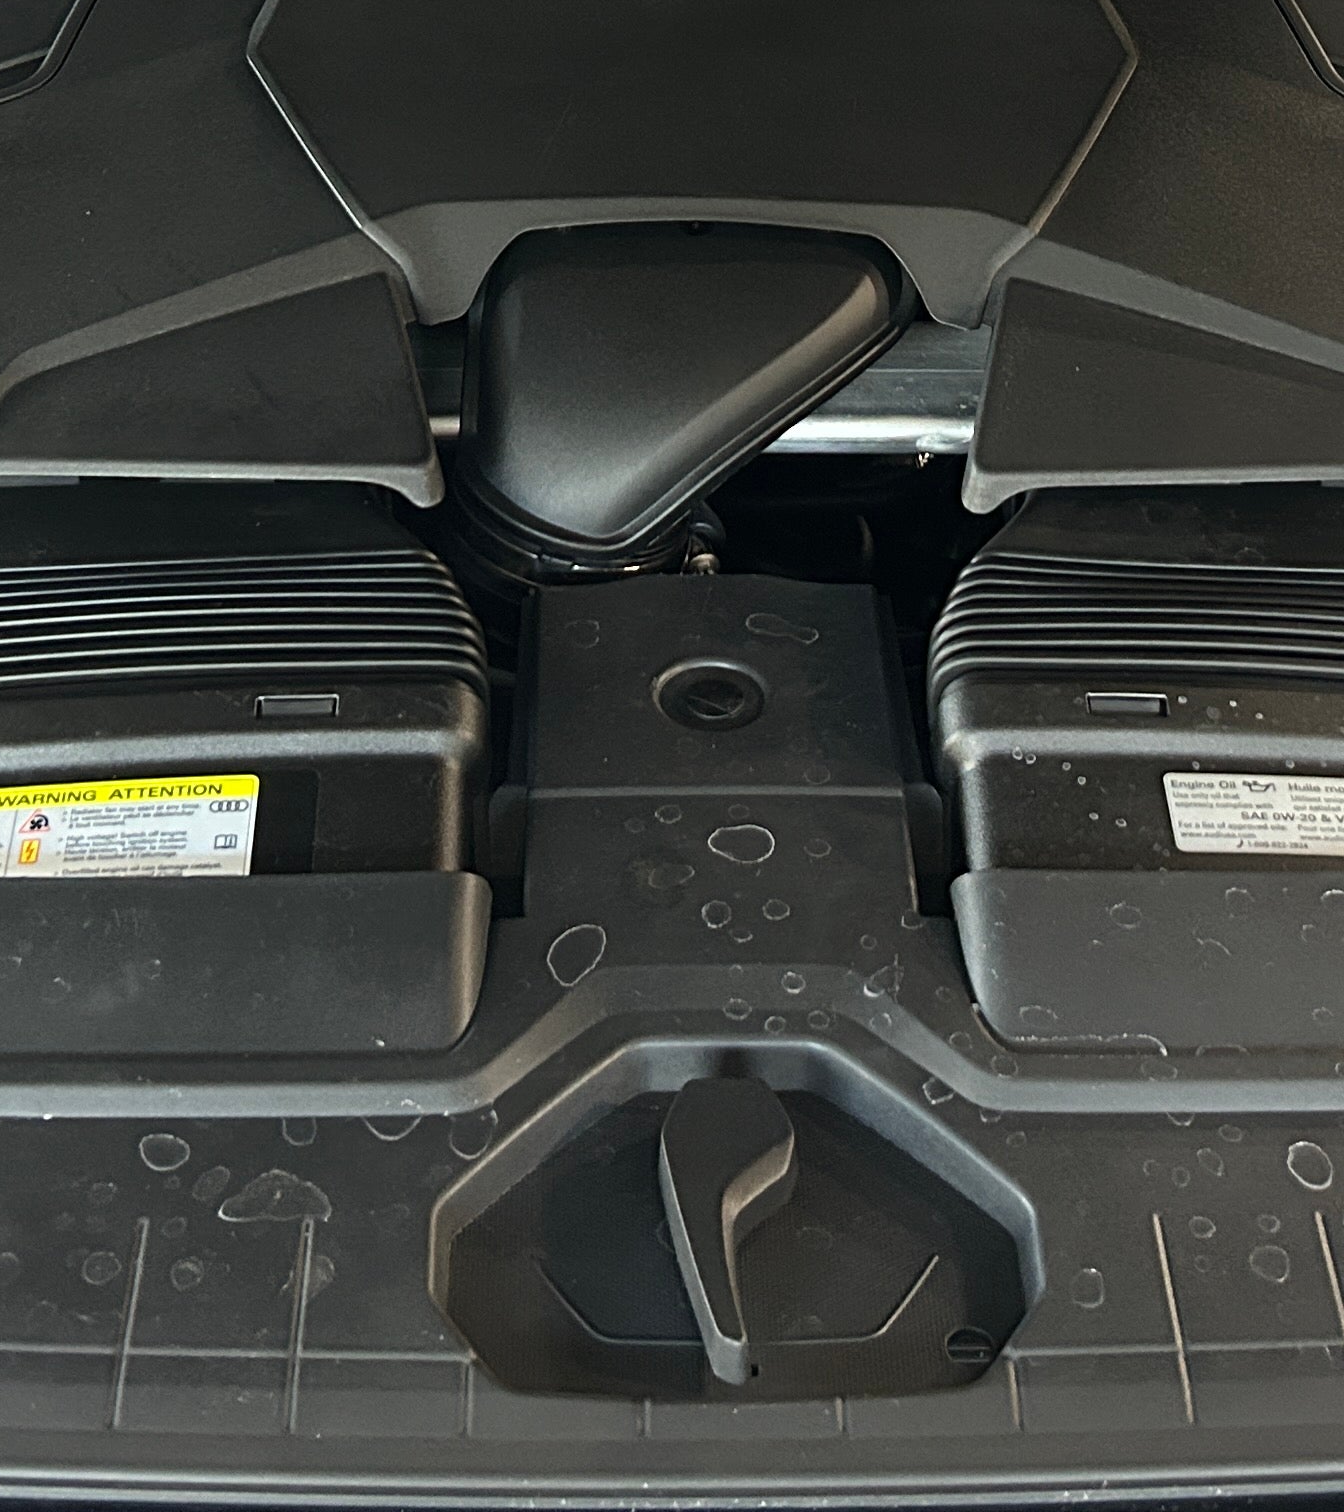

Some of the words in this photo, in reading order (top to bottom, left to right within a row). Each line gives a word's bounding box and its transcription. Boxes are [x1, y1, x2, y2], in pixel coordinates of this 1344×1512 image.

[1171, 779, 1214, 789] Engine
[1219, 780, 1236, 789] Oil
[1288, 783, 1321, 792] Huile
[108, 784, 223, 800] ATTENTION
[1241, 811, 1268, 820] SAE
[1321, 814, 1332, 822] &
